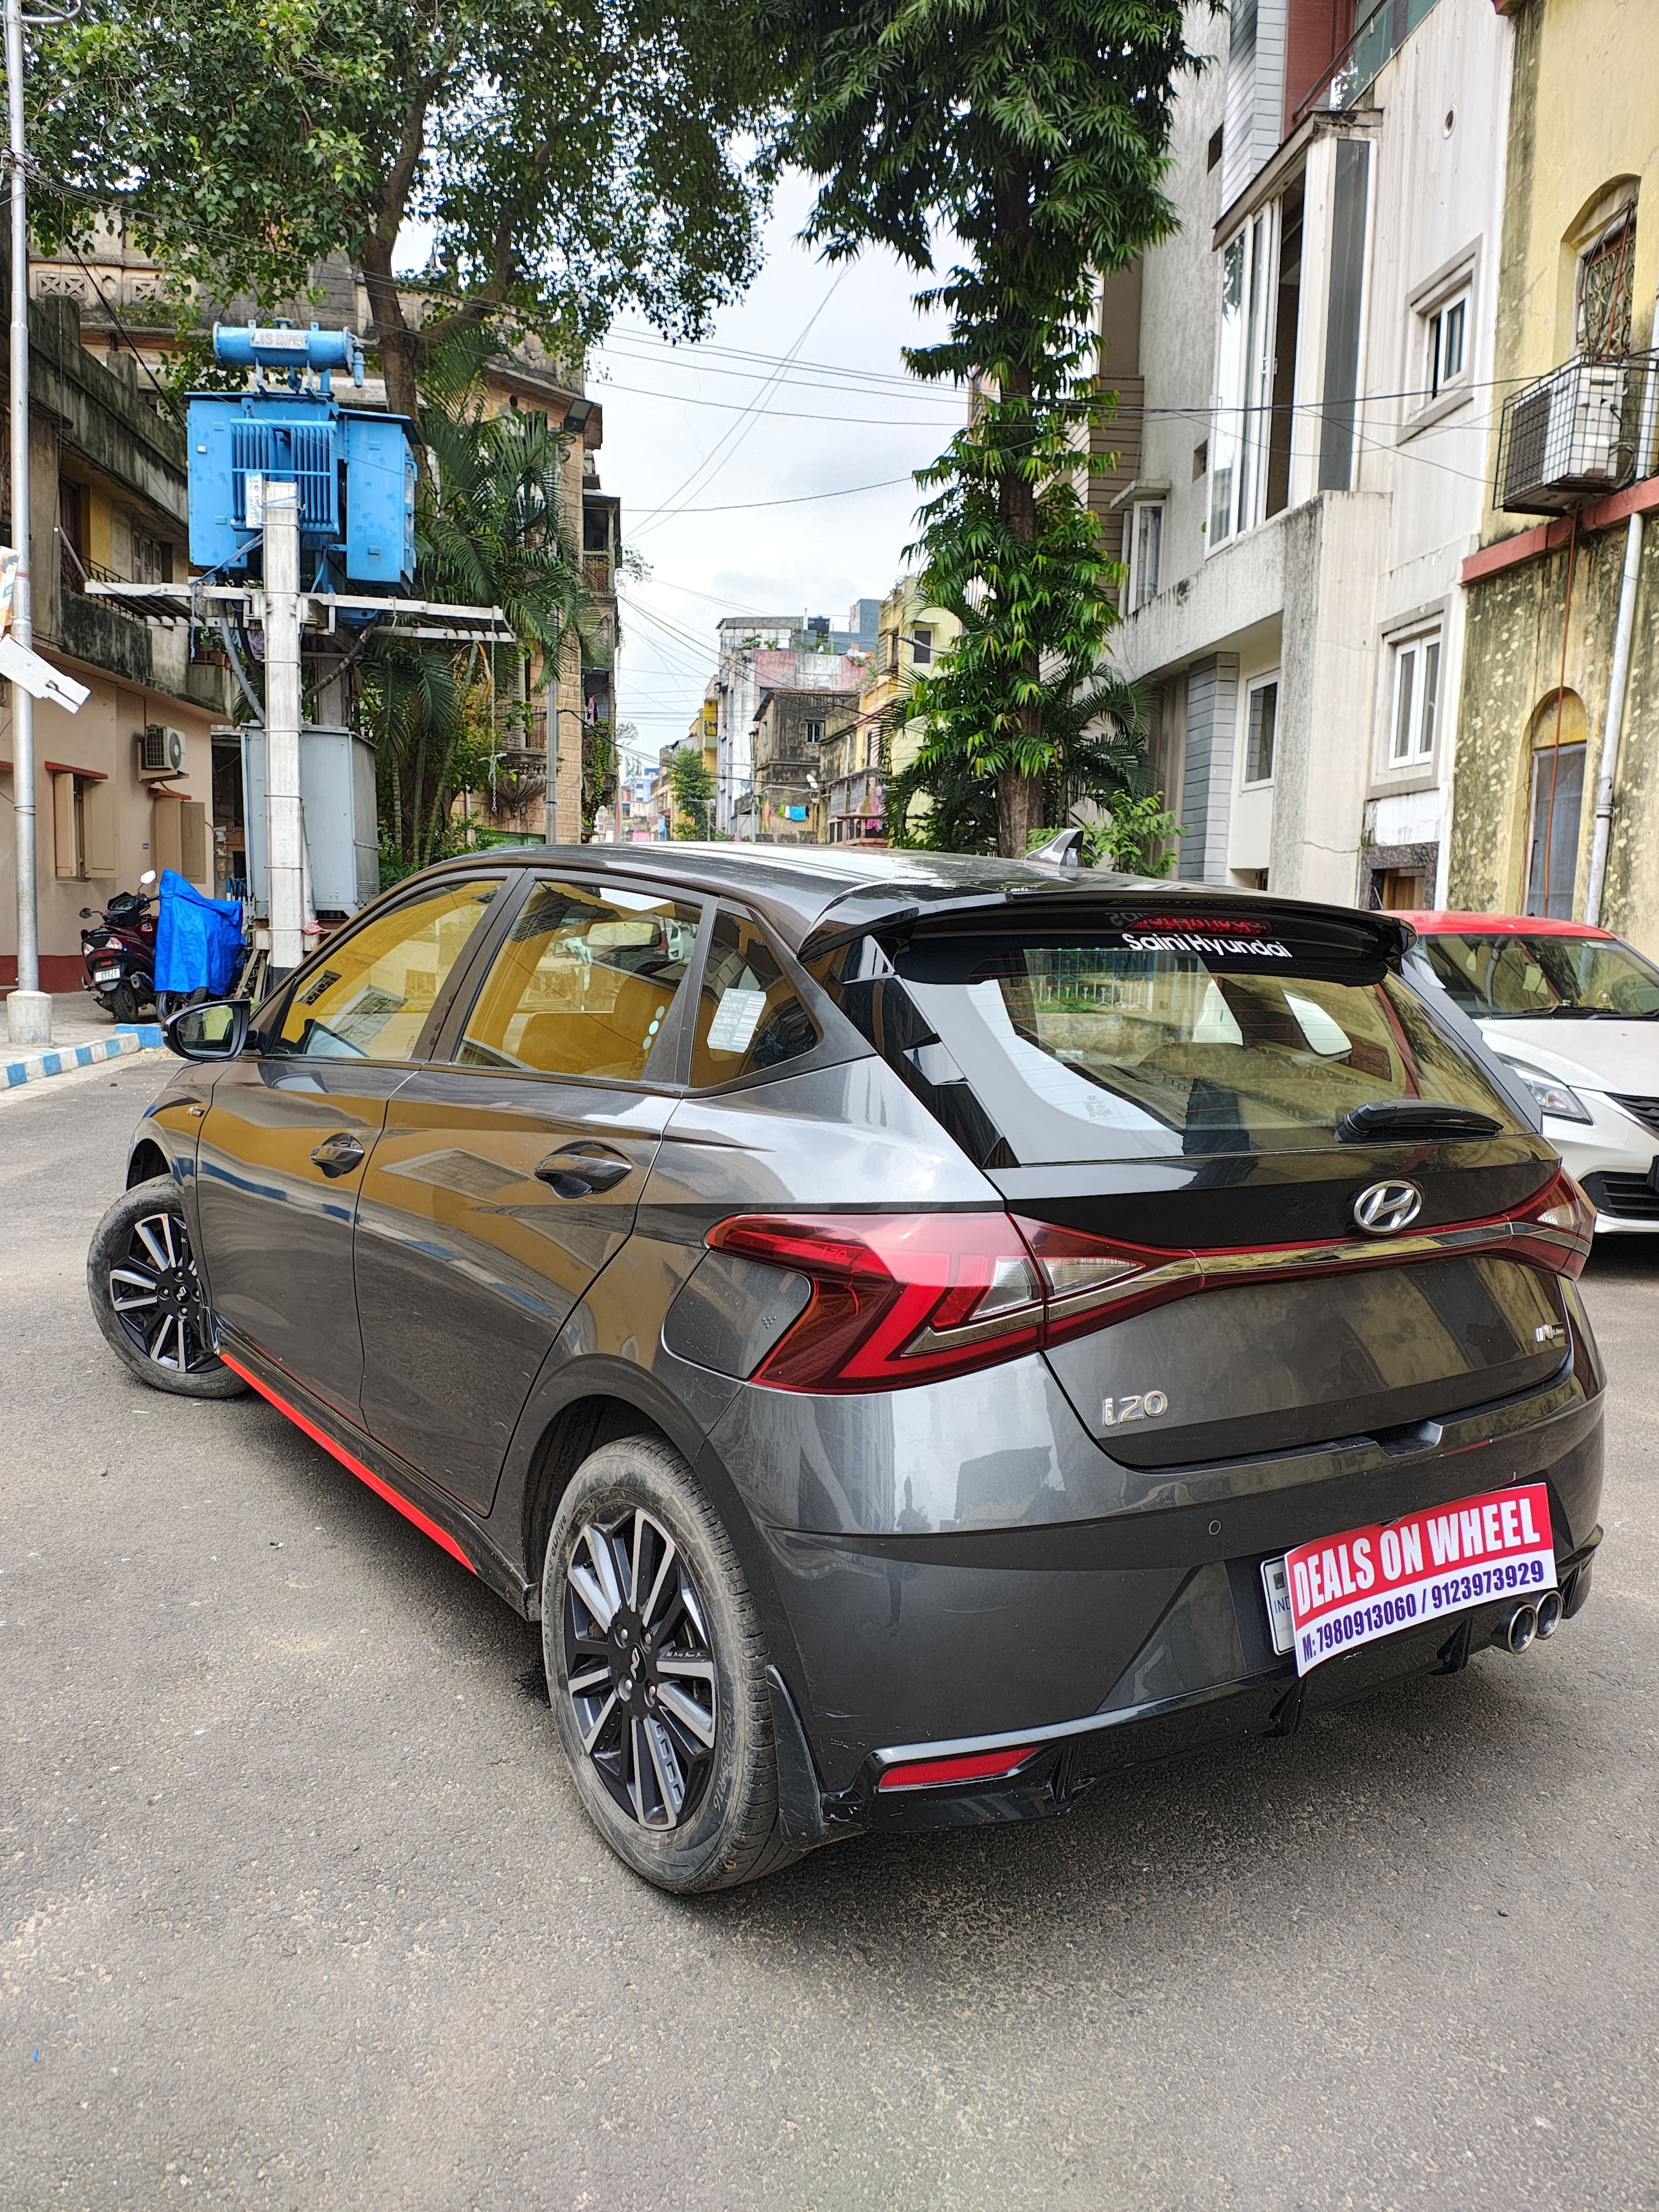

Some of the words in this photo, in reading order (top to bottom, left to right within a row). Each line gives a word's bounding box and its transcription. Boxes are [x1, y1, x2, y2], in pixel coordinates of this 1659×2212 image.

[1122, 933, 1191, 951] Saini
[1183, 933, 1293, 958] Hyundai
[1104, 1390, 1168, 1426] i20
[1293, 1537, 1375, 1617] DEALS
[1380, 1522, 1424, 1581] ON
[1426, 1498, 1541, 1566] WHEEL
[1316, 1593, 1417, 1654] 7980913060
[1431, 1559, 1544, 1609] 9123973929
